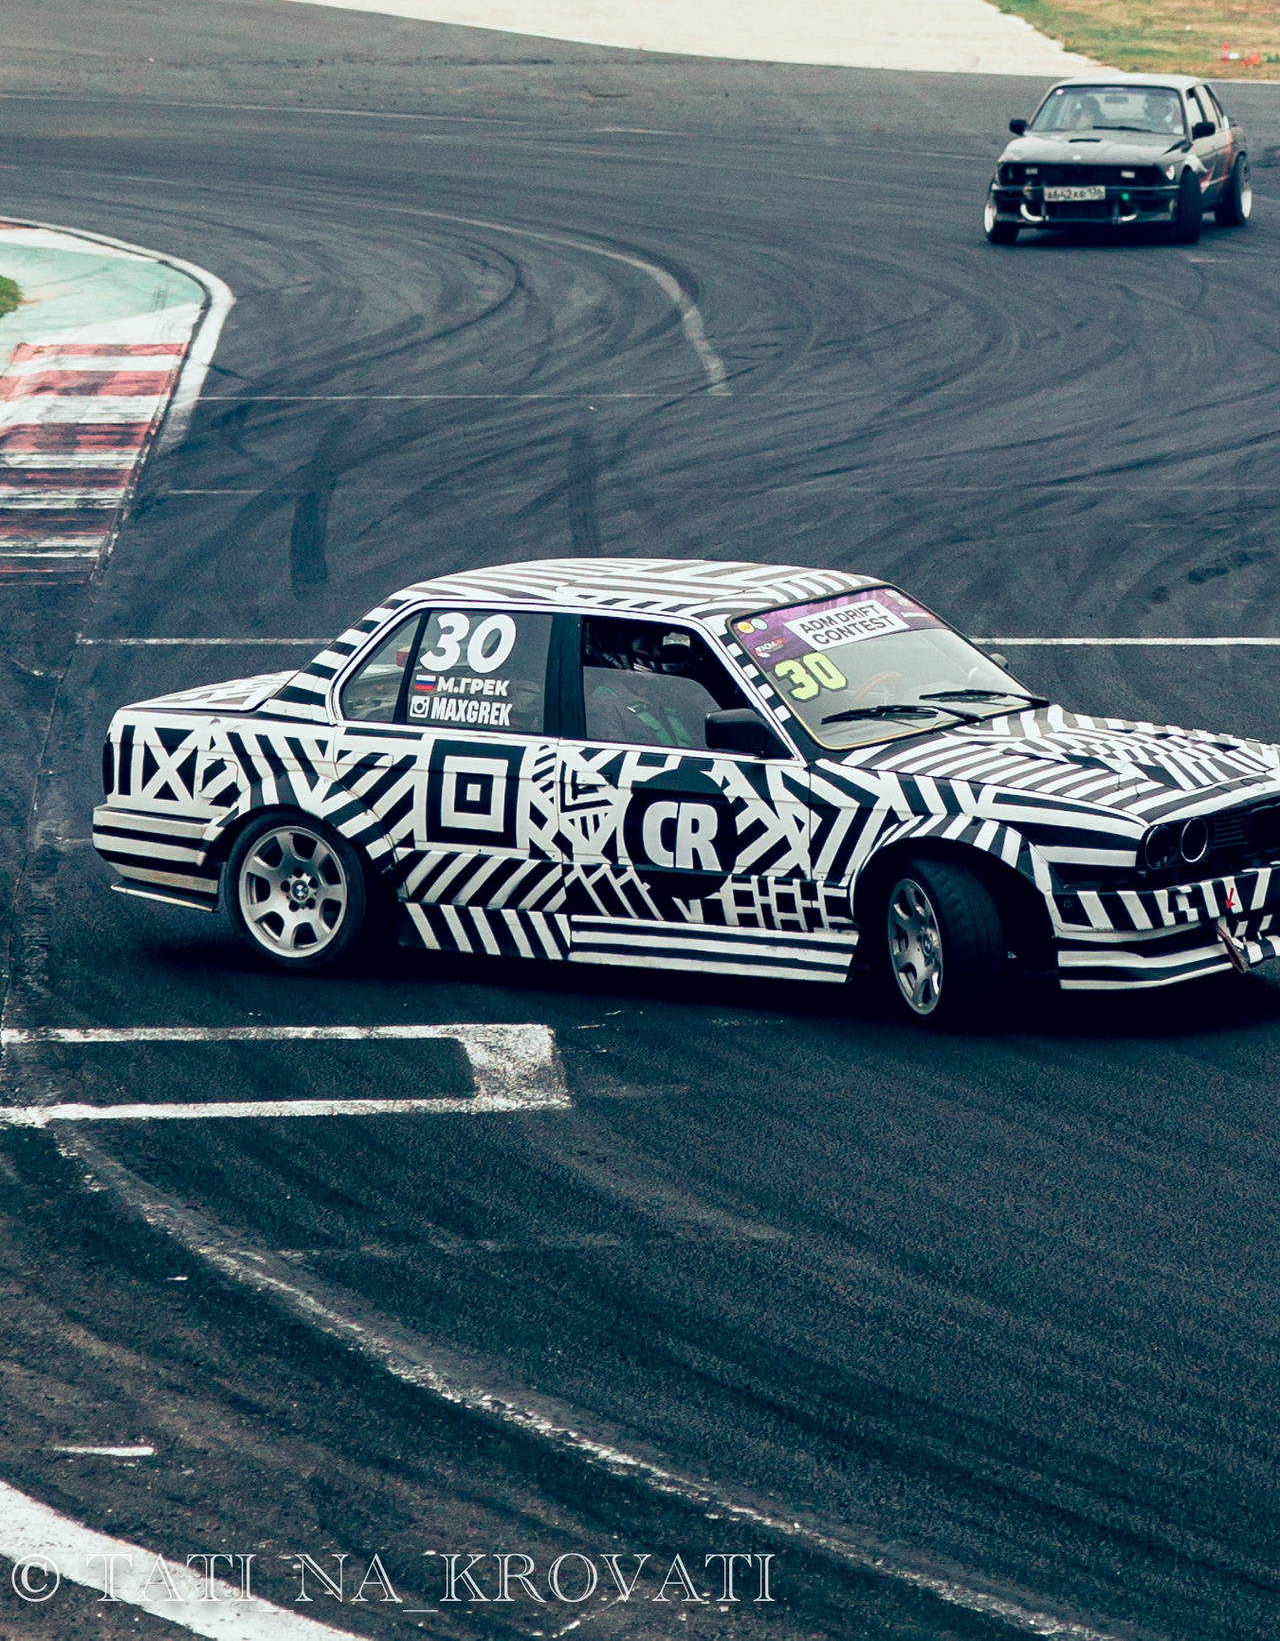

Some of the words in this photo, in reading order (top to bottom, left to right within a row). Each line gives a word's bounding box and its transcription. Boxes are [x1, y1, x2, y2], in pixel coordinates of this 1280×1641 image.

[800, 616, 837, 634] ADM
[838, 604, 881, 623] DRIFT
[812, 615, 895, 645] CONTEST
[419, 612, 517, 674] 30
[774, 652, 848, 701] 30
[431, 697, 513, 727] MAXGREK
[642, 801, 722, 872] CR
